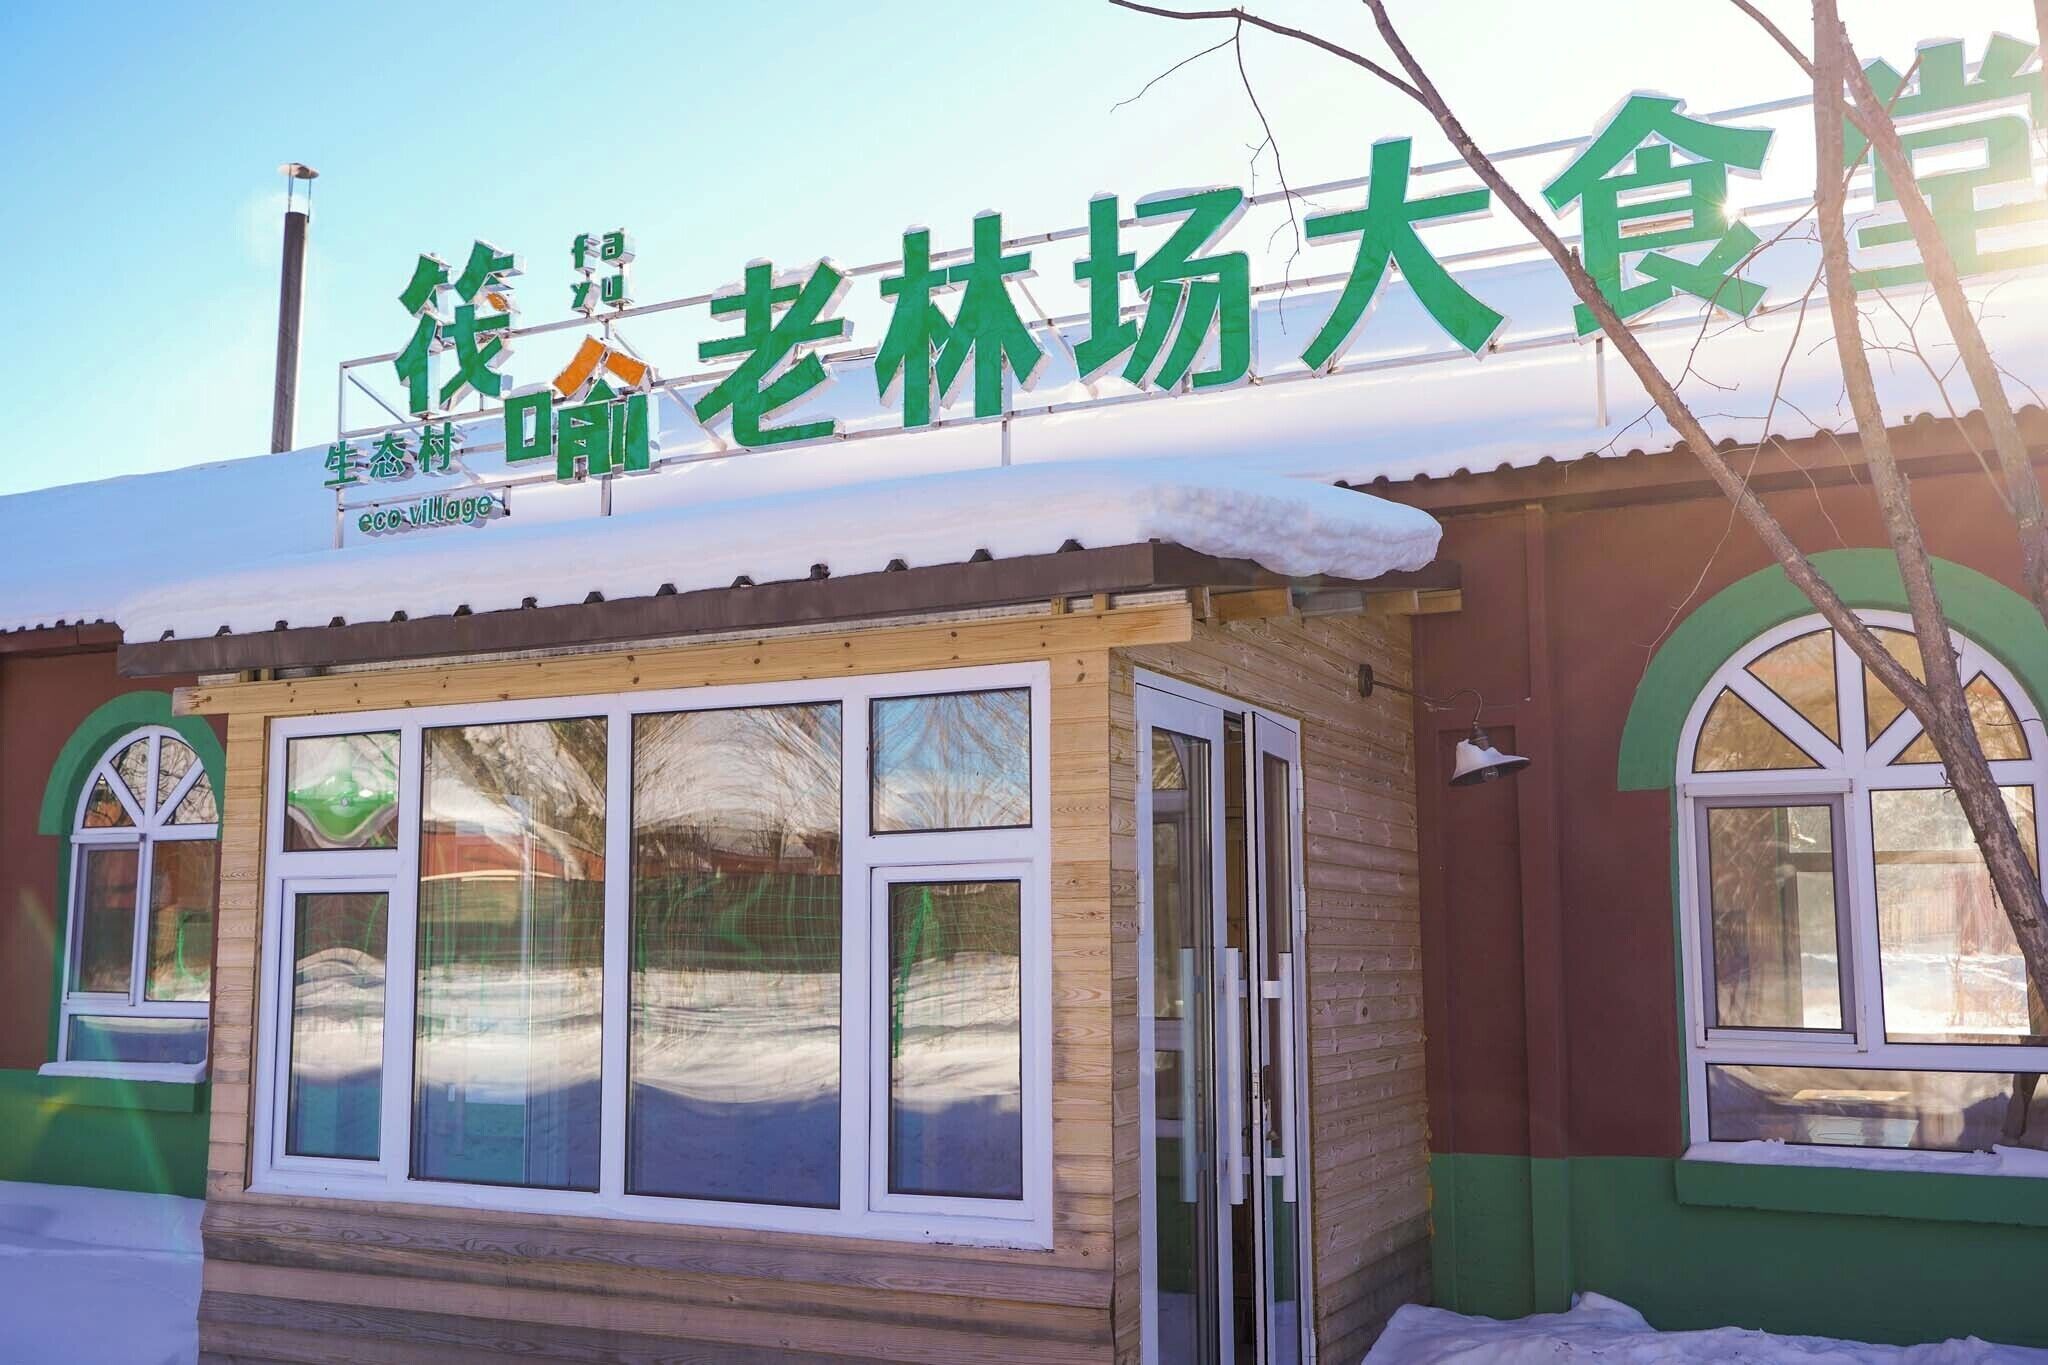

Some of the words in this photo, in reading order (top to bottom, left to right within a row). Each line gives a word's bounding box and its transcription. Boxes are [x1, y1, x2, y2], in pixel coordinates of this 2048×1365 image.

[572, 231, 625, 271] fa
[324, 422, 453, 487] 生态村
[358, 509, 402, 533] eco
[407, 494, 493, 525] village
